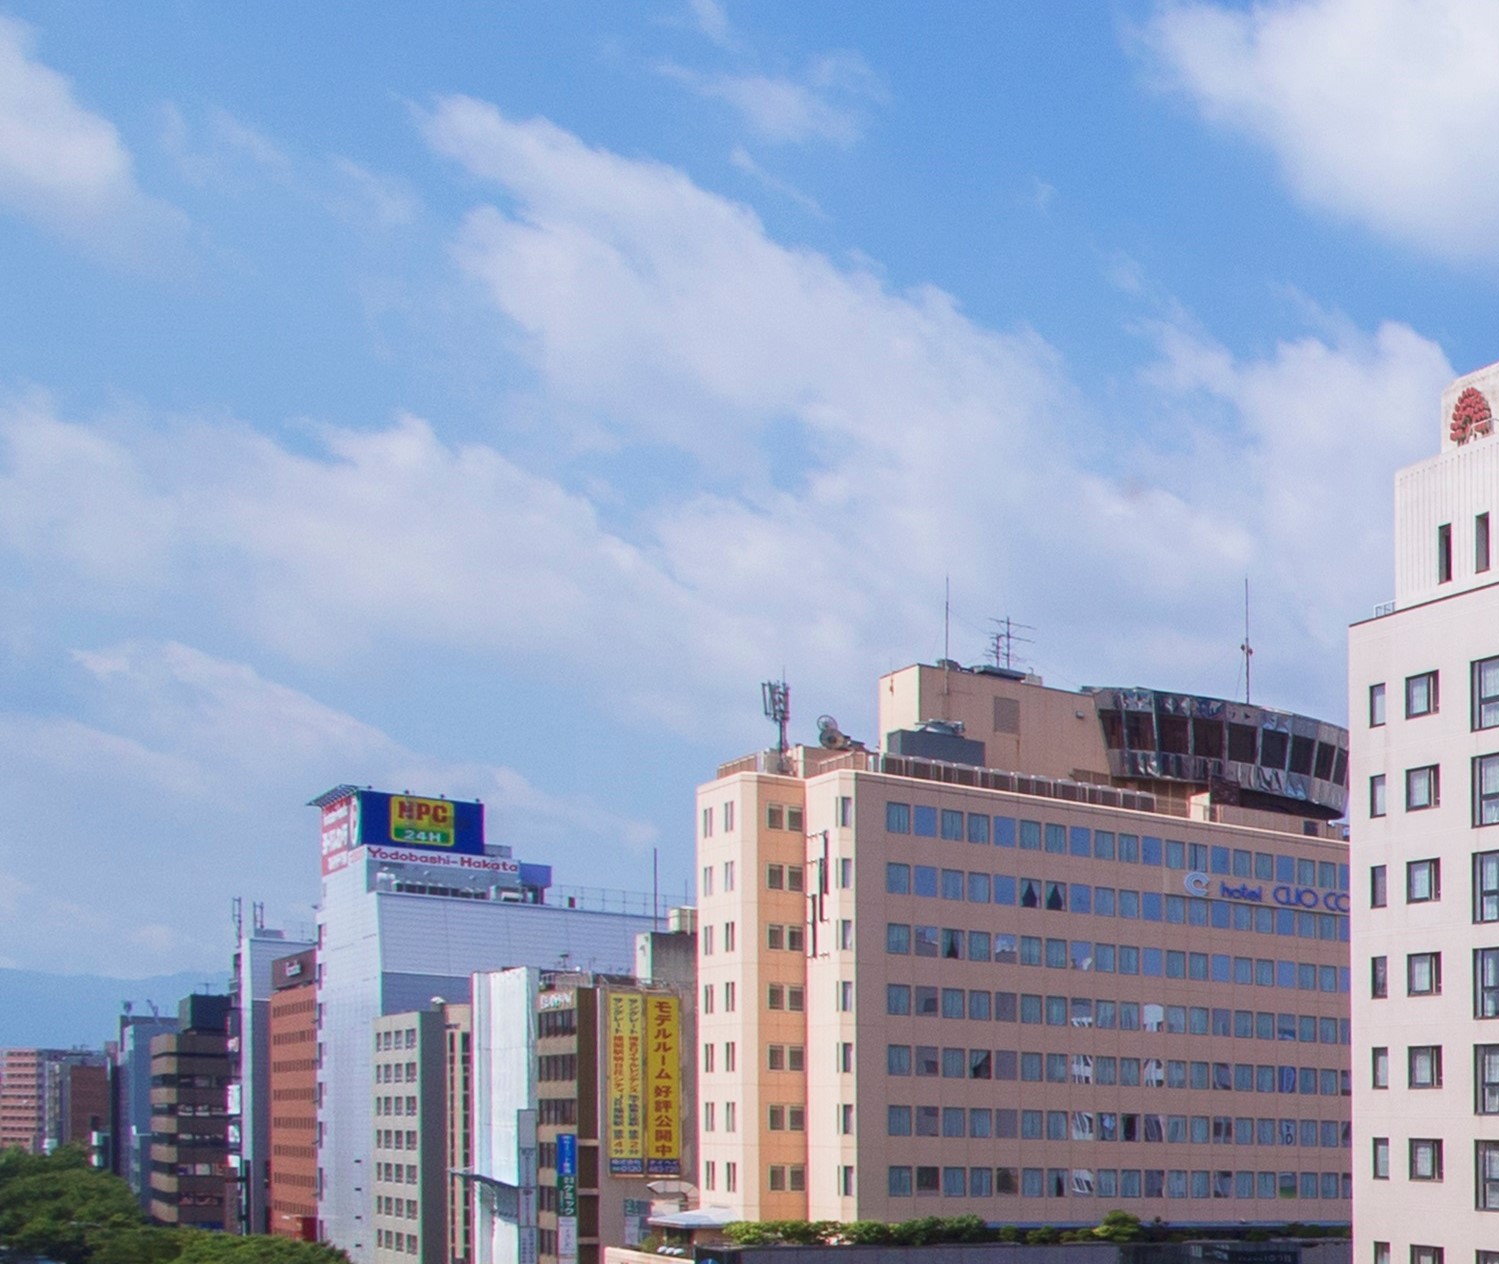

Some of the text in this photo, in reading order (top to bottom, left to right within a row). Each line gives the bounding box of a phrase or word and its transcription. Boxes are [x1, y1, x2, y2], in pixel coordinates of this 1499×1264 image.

[398, 800, 448, 825] NPC
[404, 829, 442, 843] 24H
[368, 846, 518, 873] Yodobashi-Hakata
[1220, 881, 1263, 902] hotel
